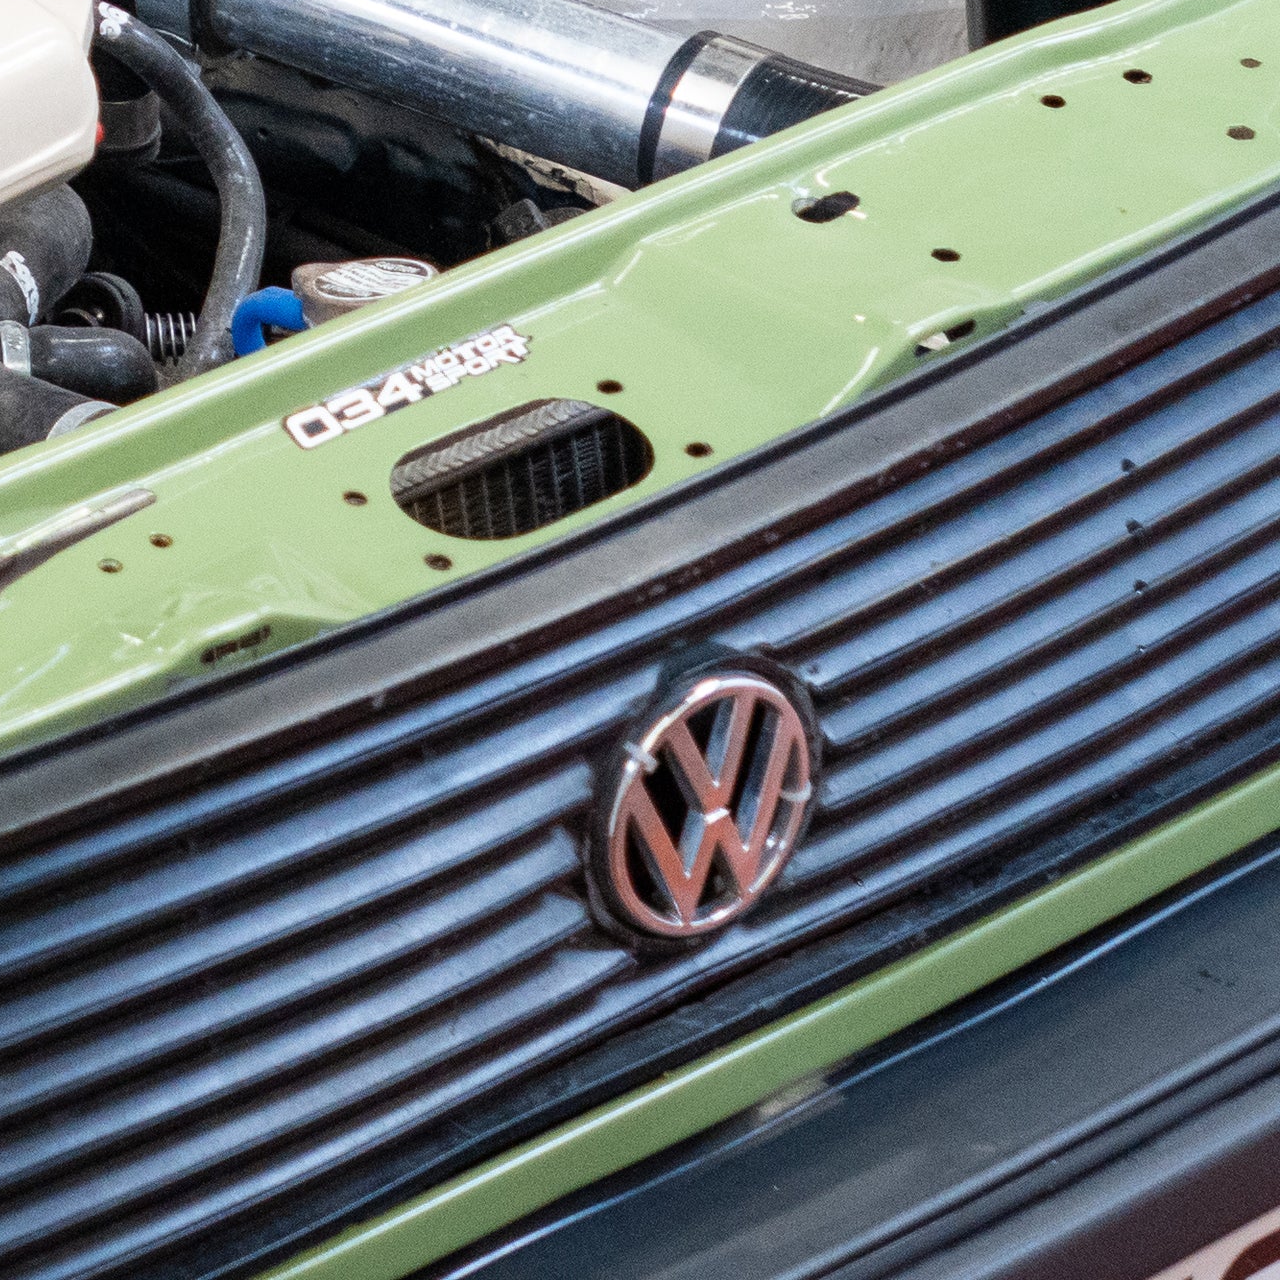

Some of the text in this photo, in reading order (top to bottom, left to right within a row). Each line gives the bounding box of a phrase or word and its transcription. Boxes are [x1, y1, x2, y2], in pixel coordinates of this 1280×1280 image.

[285, 325, 532, 449] 034 MOTOR
[422, 341, 530, 393] SPORT
